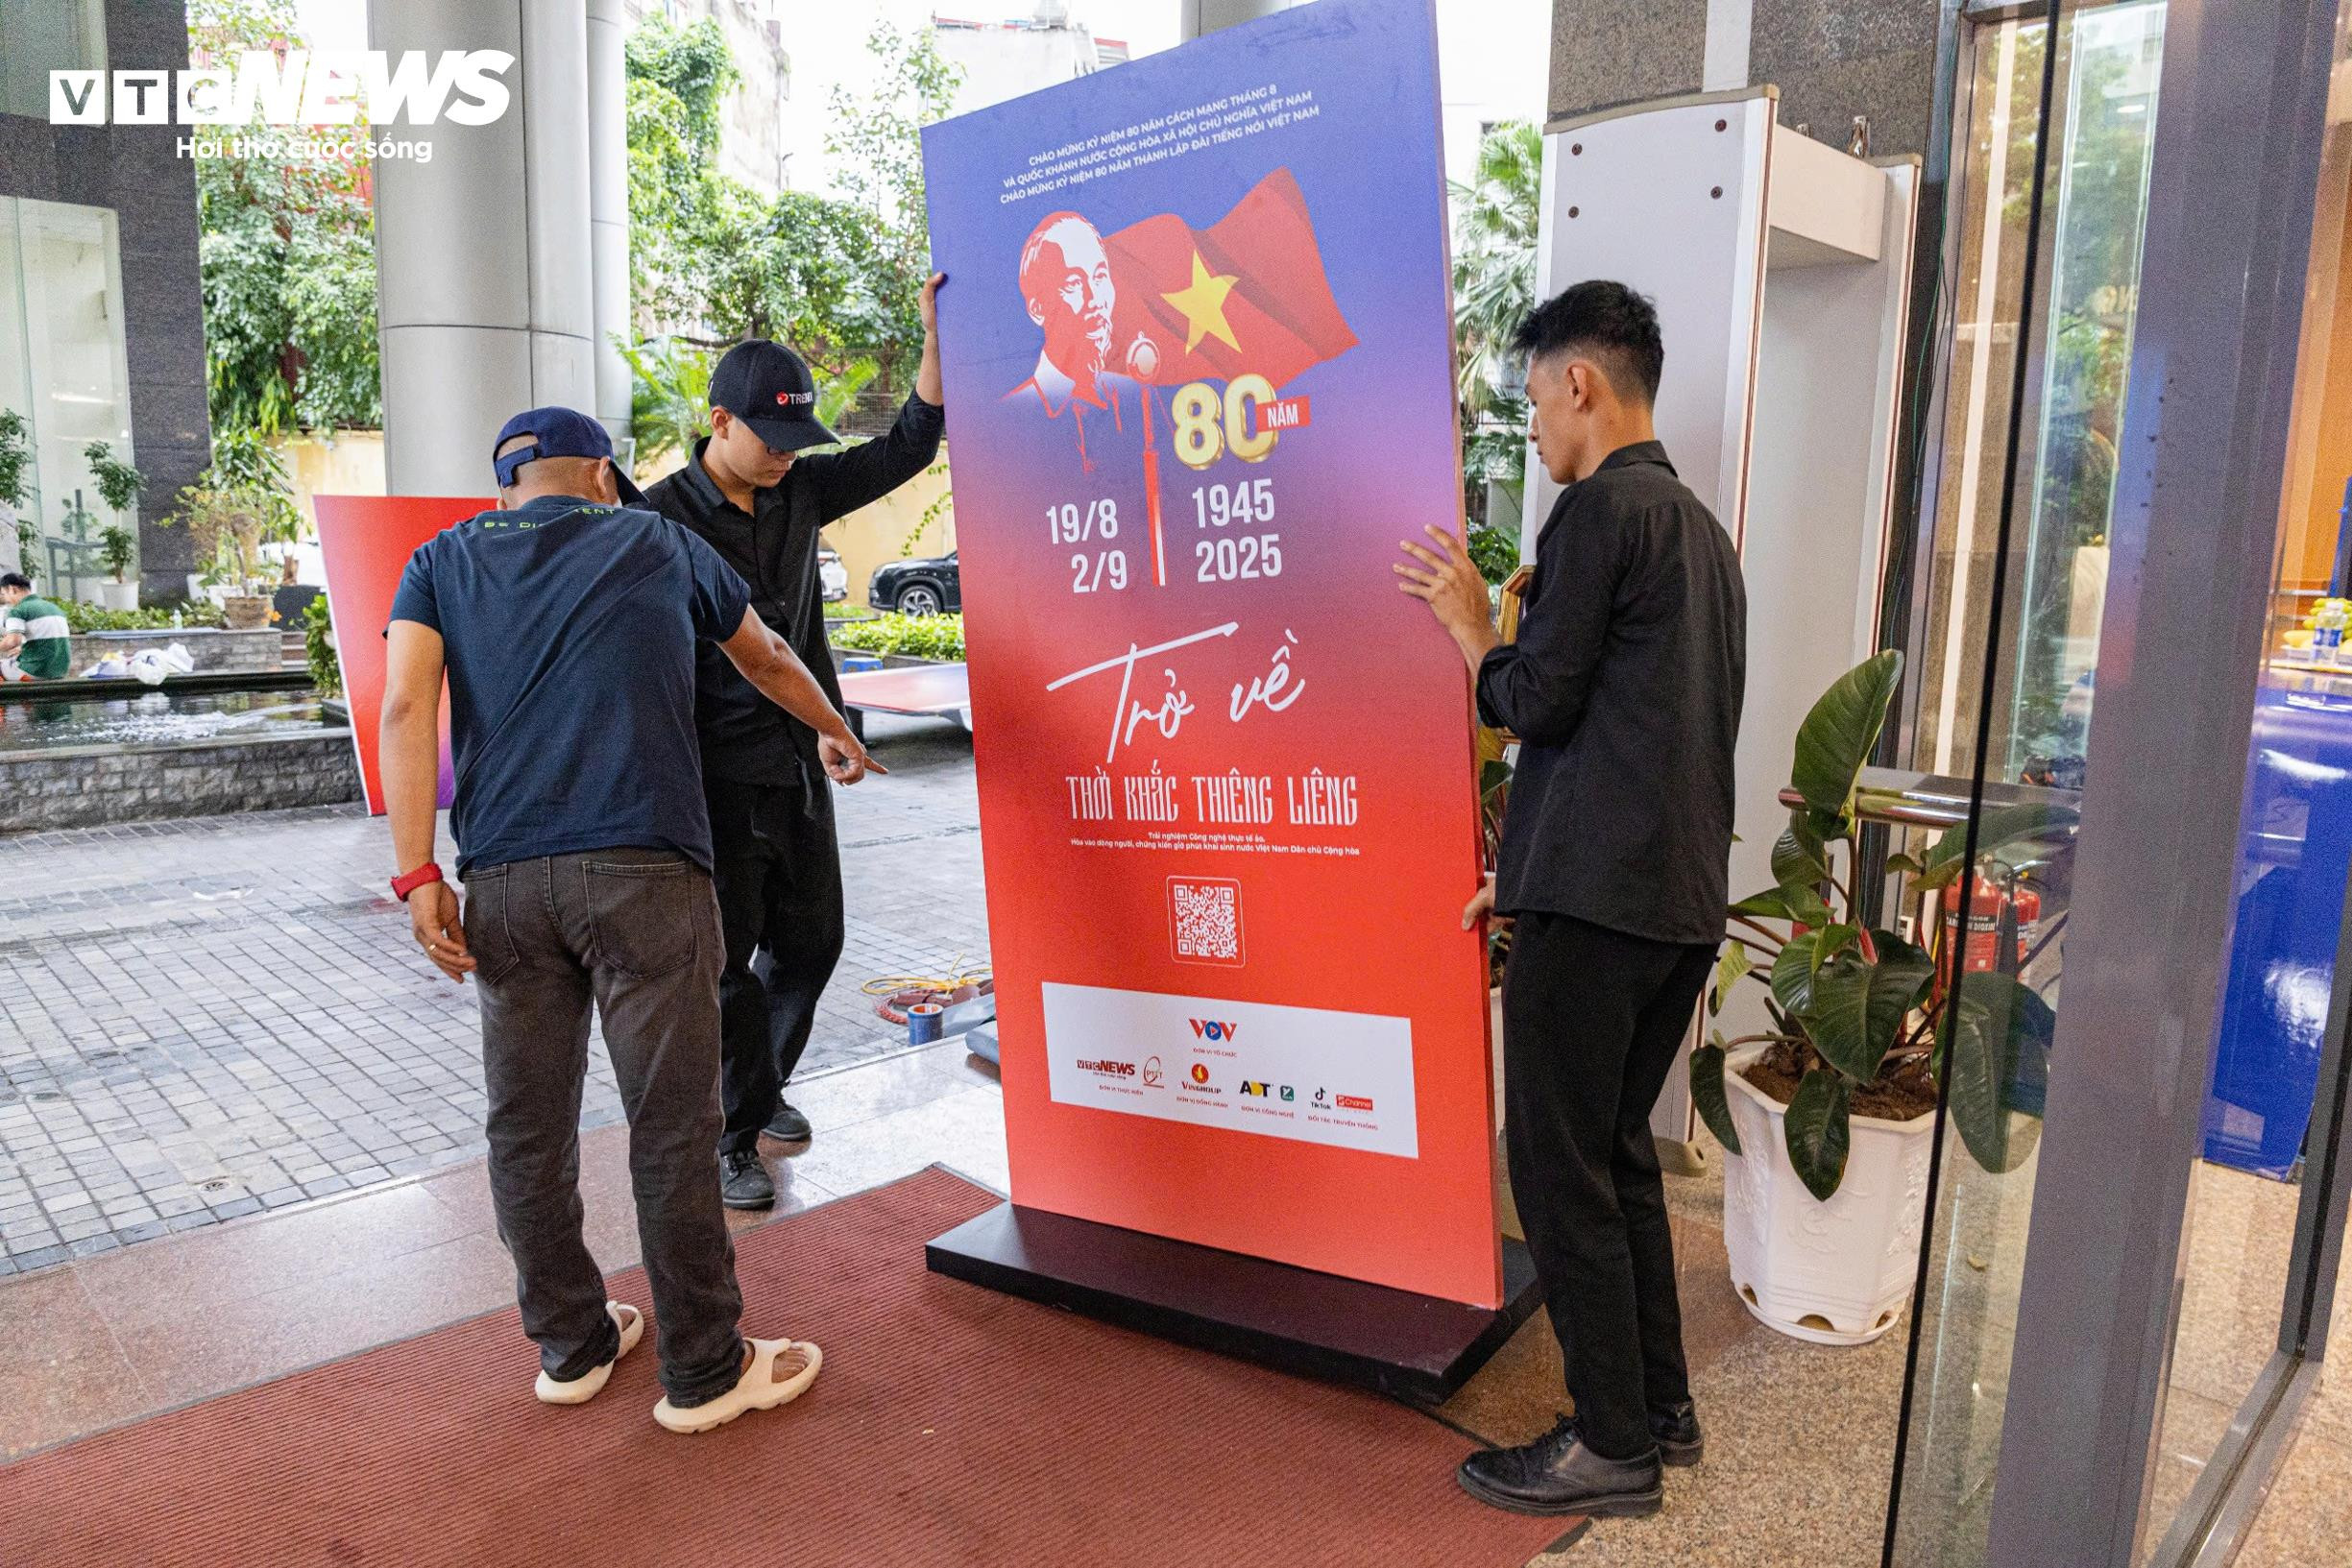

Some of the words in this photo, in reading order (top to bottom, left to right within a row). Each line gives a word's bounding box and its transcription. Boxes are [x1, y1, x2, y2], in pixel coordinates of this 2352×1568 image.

[1000, 189, 1026, 205] CHÀO
[1027, 181, 1055, 197] MỪNG
[1055, 175, 1068, 188] KỲ
[1070, 167, 1093, 184] NIỆM
[1095, 165, 1107, 178] 80
[1109, 159, 1131, 175] NĂM
[1133, 149, 1168, 167] THÀNH
[1170, 141, 1190, 157] LẬP
[1191, 136, 1210, 151] ĐÀI
[1212, 127, 1243, 143] TIẾNG
[1245, 120, 1265, 135] NÓI
[1267, 112, 1292, 130] VIỆT
[1293, 105, 1320, 121] NAM
[1003, 177, 1016, 188] VÀ
[1017, 166, 1044, 185] QUỐC
[1045, 158, 1079, 177] KHÁNH
[1079, 149, 1107, 167] NƯỚC
[1109, 141, 1137, 158] CỘNG
[1139, 134, 1161, 149] HÒA
[1163, 128, 1176, 143] XÃ
[1178, 124, 1197, 138] HỘI
[1199, 114, 1222, 132] CHỦ
[1224, 104, 1258, 125] NGHĨA
[1260, 97, 1284, 113] VIỆT
[1286, 90, 1313, 107] NAM
[1030, 151, 1055, 166] CHÀO
[1056, 141, 1085, 158] MỪNG
[1086, 135, 1099, 150] KỲ
[1101, 129, 1125, 145] NIỆM
[1127, 126, 1139, 137] 80
[1141, 117, 1164, 133] NĂM
[1166, 109, 1195, 126] CÁCH
[1197, 99, 1228, 117] MẠNG
[1230, 87, 1267, 107] THÁNG
[1269, 84, 1277, 95] 8
[1172, 373, 1279, 470] 80
[1267, 403, 1299, 428] NĂM
[1046, 497, 1118, 544] 19/8
[1192, 477, 1275, 528] 1945
[1071, 549, 1128, 593] 2/9
[1195, 533, 1282, 583] 2025
[1046, 621, 1239, 763] Trở
[1229, 628, 1306, 722] về
[1065, 765, 1114, 820] THỜI
[1124, 759, 1179, 822] KHẮC
[1191, 767, 1273, 824] THIÊNG
[1286, 767, 1358, 826] LIÊNG
[1189, 1018, 1237, 1043] VOV
